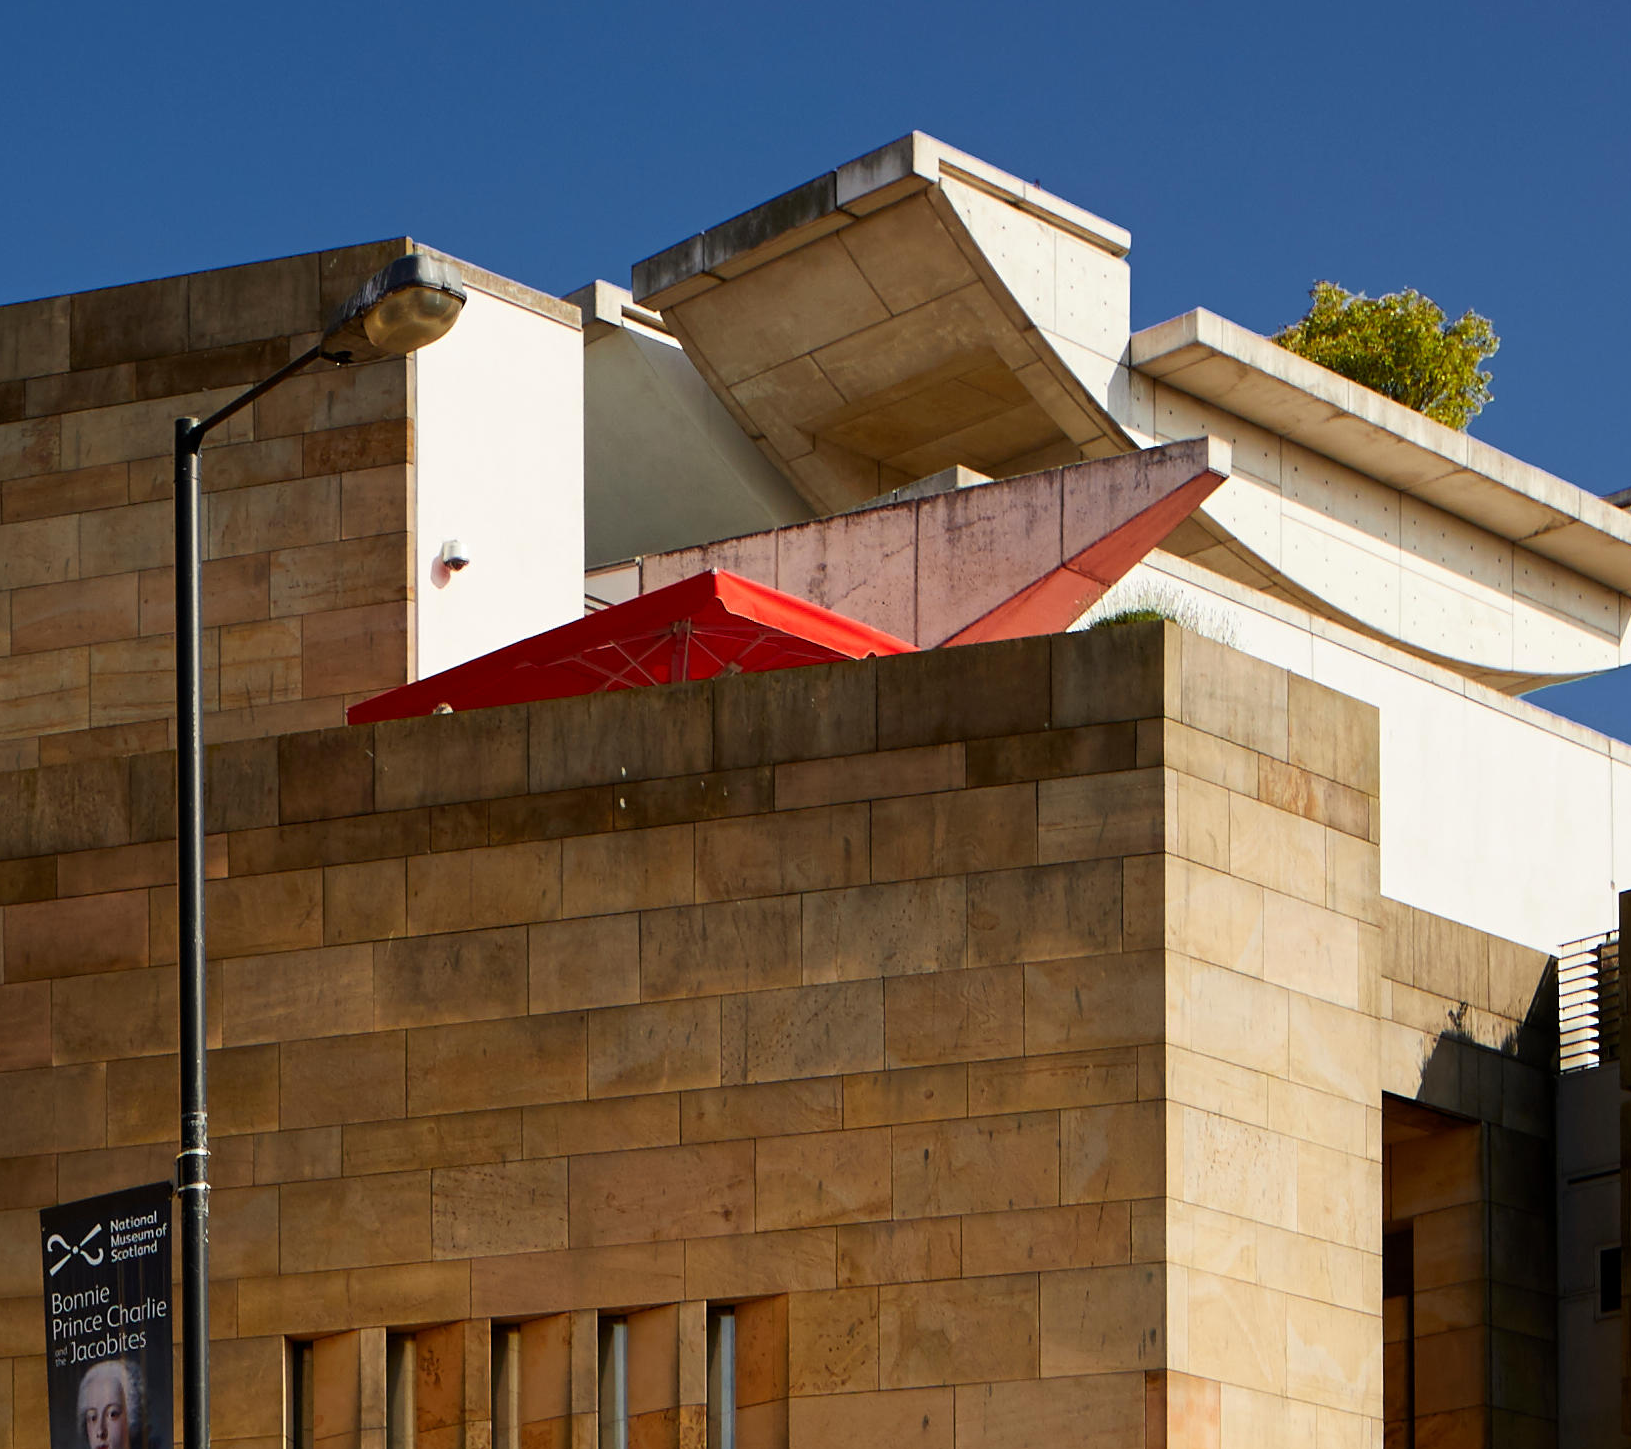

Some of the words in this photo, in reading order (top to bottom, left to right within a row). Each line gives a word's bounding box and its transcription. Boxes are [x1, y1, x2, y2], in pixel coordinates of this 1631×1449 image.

[110, 1210, 158, 1234] National
[110, 1228, 154, 1249] Museum
[155, 1222, 168, 1239] of
[110, 1240, 158, 1263] Scotland
[51, 1284, 111, 1315] Bonnie
[52, 1314, 103, 1341] Prince
[106, 1297, 168, 1327] Charlie
[70, 1331, 147, 1365] Jacobites
